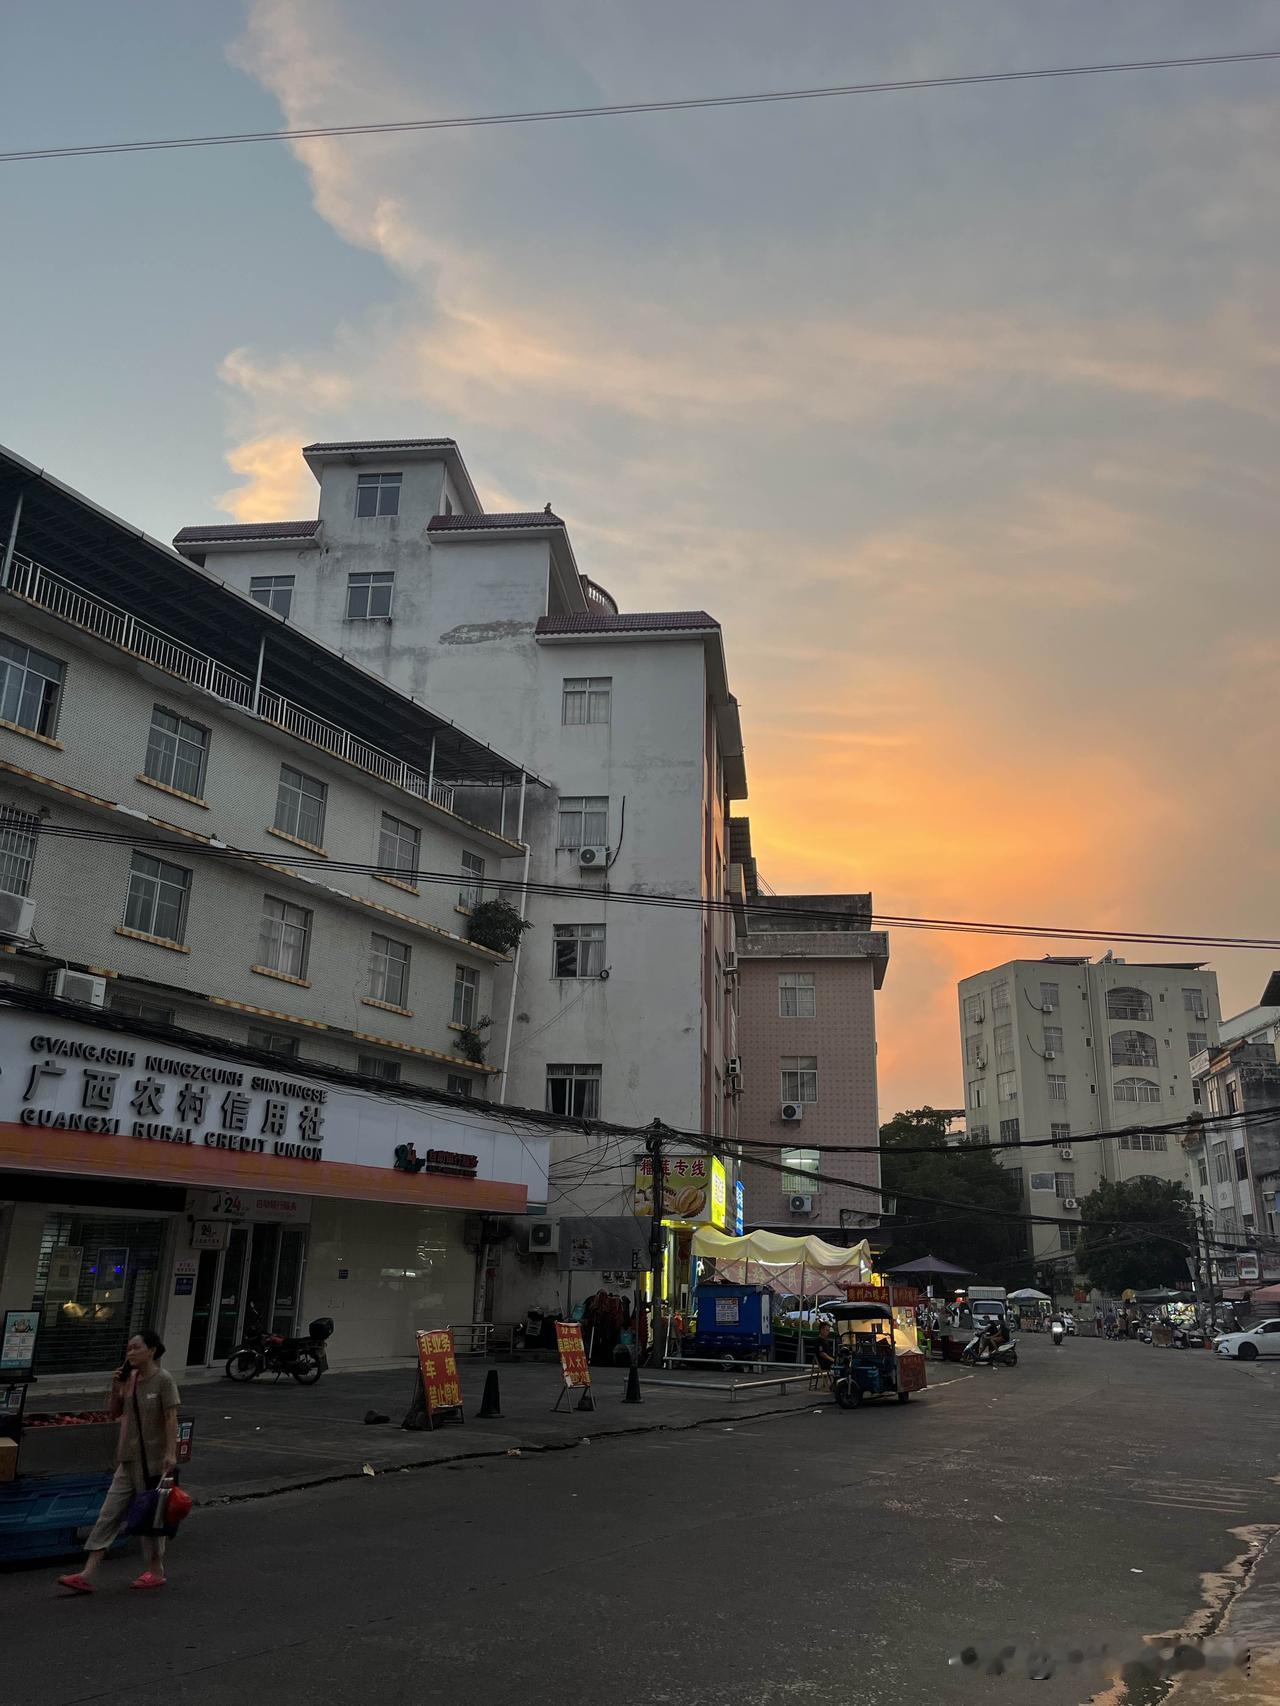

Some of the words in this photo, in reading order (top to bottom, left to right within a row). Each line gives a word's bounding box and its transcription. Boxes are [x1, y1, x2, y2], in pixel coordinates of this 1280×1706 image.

[23, 1060, 325, 1142] 广西农村信用社
[21, 1107, 121, 1136] GUANGXI
[132, 1121, 195, 1144] RURAL
[204, 1131, 268, 1154] CREDIT
[274, 1141, 323, 1160] UNION
[421, 1333, 451, 1355] 非业务
